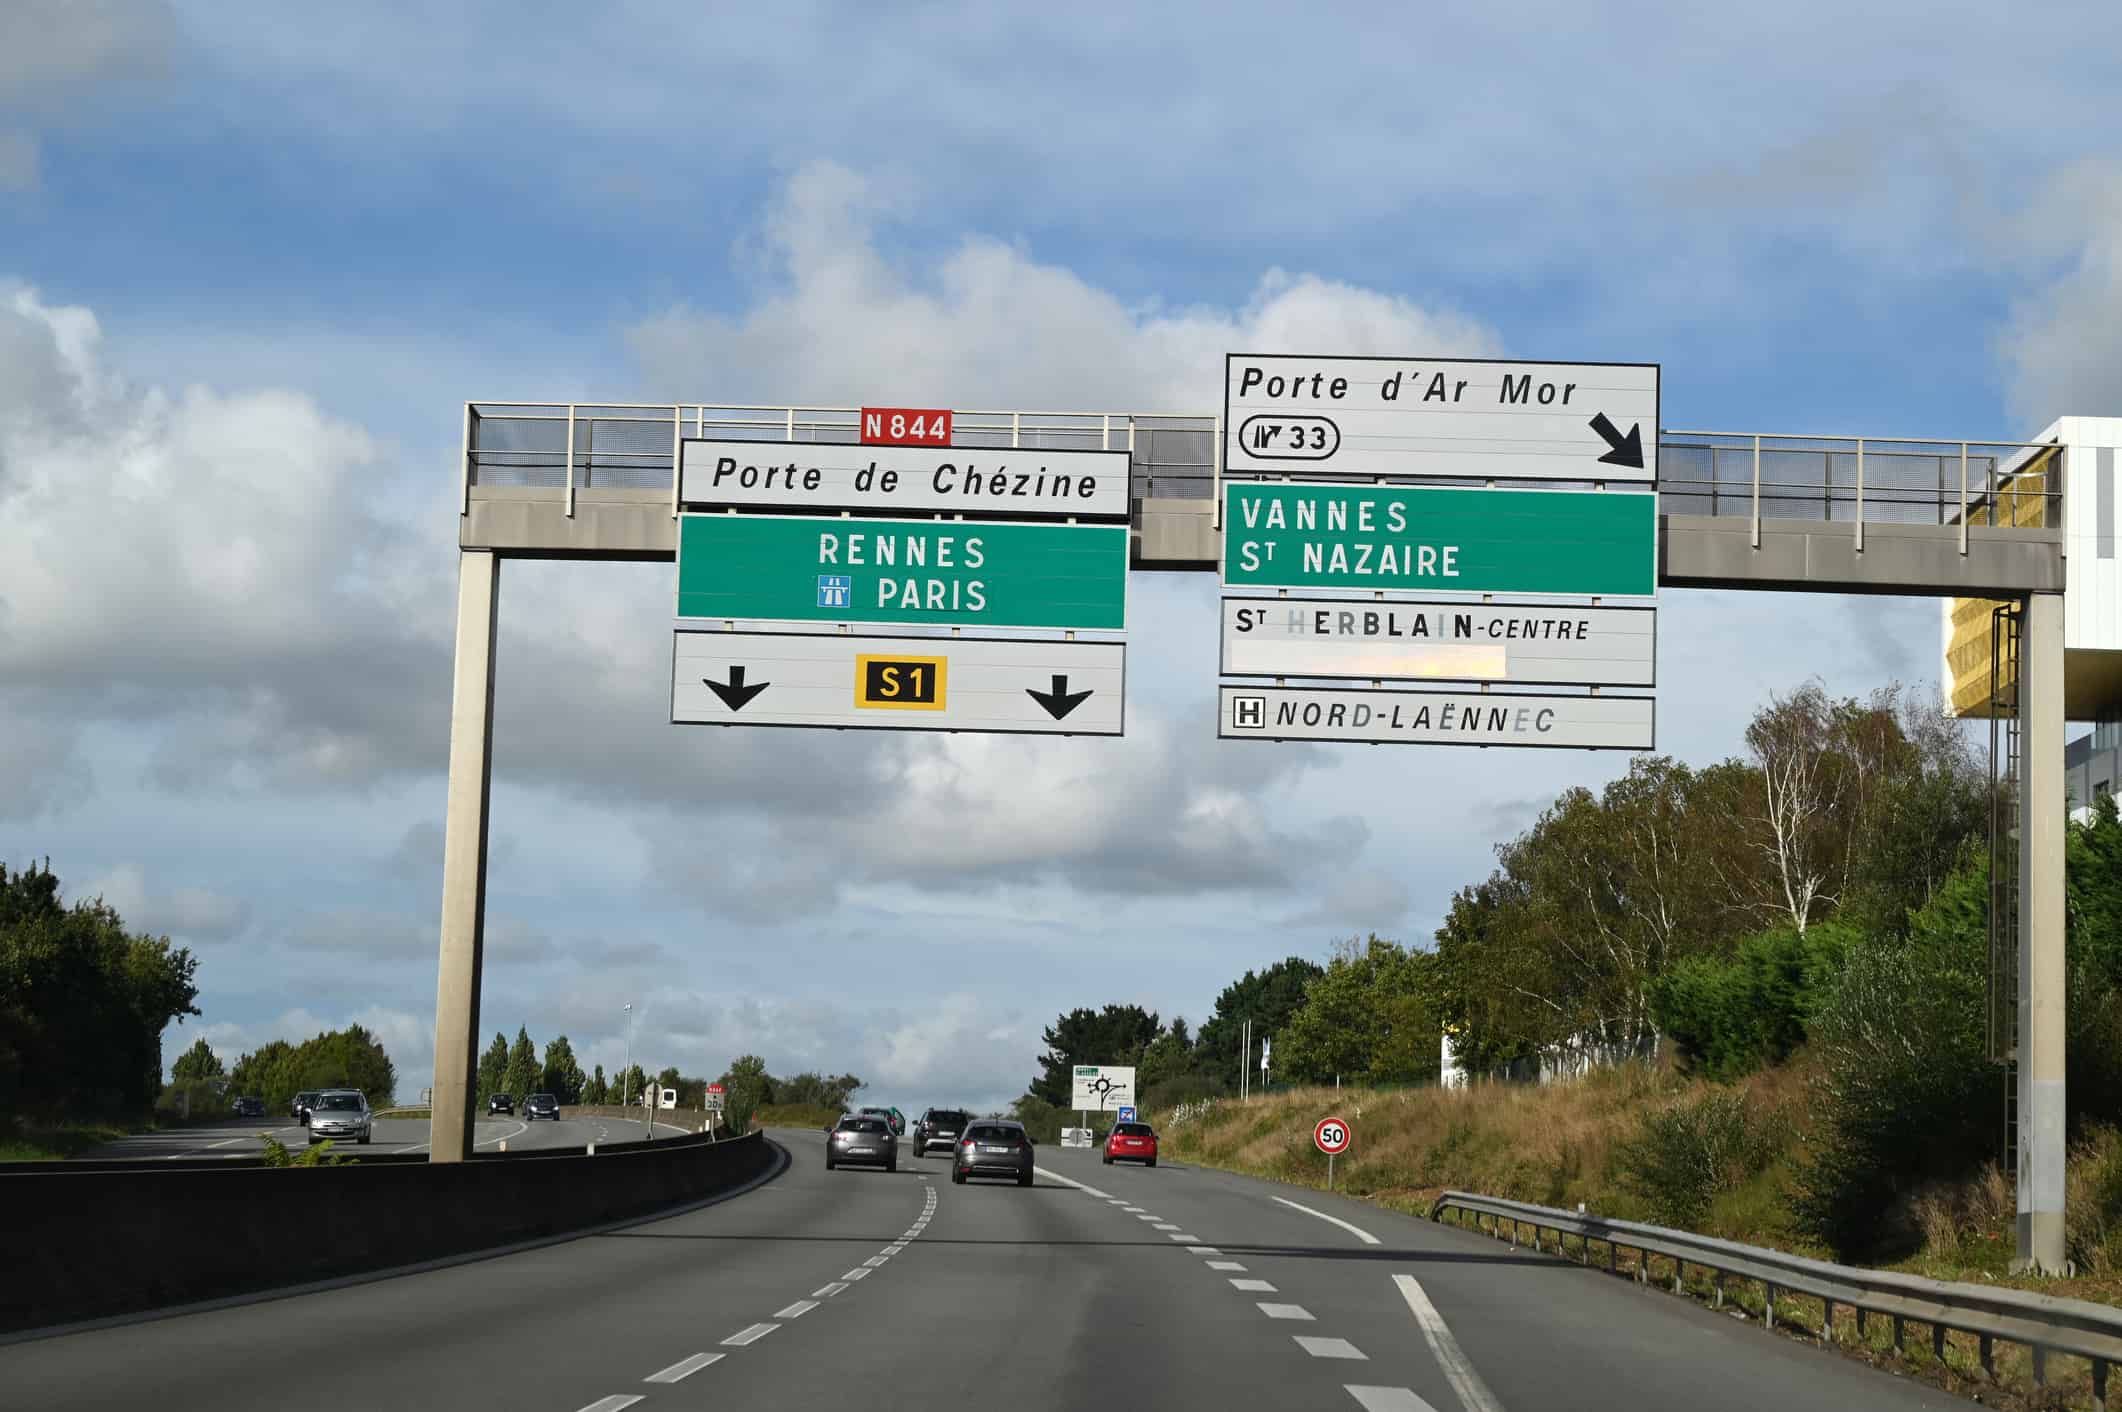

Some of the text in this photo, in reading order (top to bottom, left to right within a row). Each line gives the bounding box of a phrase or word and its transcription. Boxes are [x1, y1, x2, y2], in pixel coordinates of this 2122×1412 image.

[1240, 368, 1577, 405] Porte d'Ar Mor
[1290, 427, 1326, 449] 33
[713, 458, 1096, 498] Porte de Chézine
[1241, 498, 1407, 532] VANNES
[819, 534, 984, 568] RENNES
[1303, 543, 1459, 576] NAZAIRE
[878, 579, 986, 611] PARIS
[1240, 702, 1260, 725] H
[1277, 702, 1555, 732] NORD-LAËNNEC
[1323, 1128, 1343, 1143] 50
